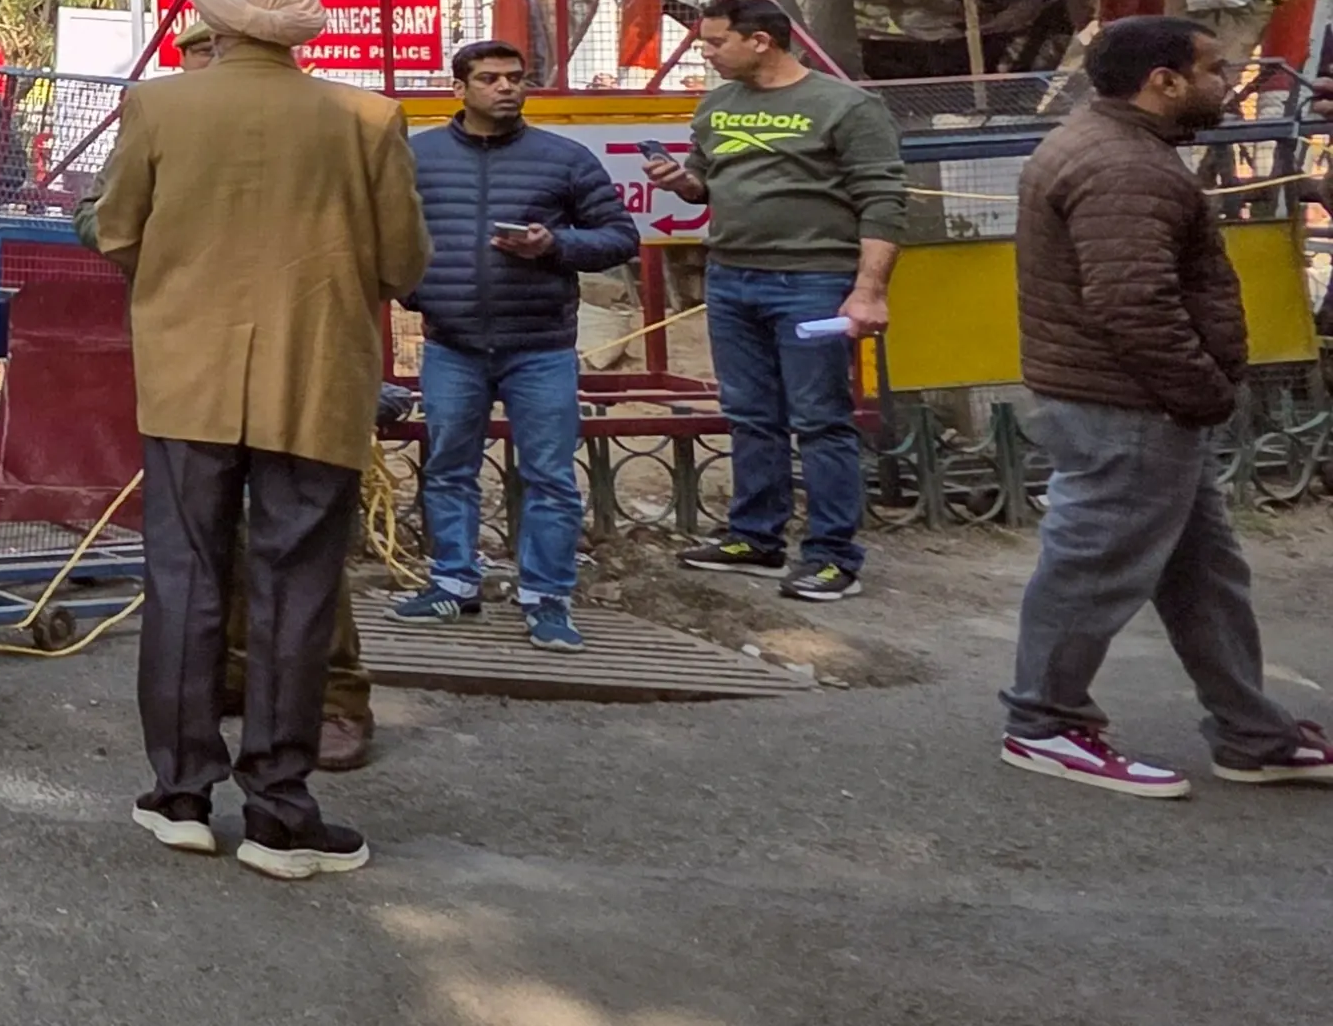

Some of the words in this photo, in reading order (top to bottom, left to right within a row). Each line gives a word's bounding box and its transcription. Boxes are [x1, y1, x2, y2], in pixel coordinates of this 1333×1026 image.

[322, 5, 438, 35] NNECESARY
[369, 45, 432, 60] PLICE
[711, 111, 813, 131] Reebok
